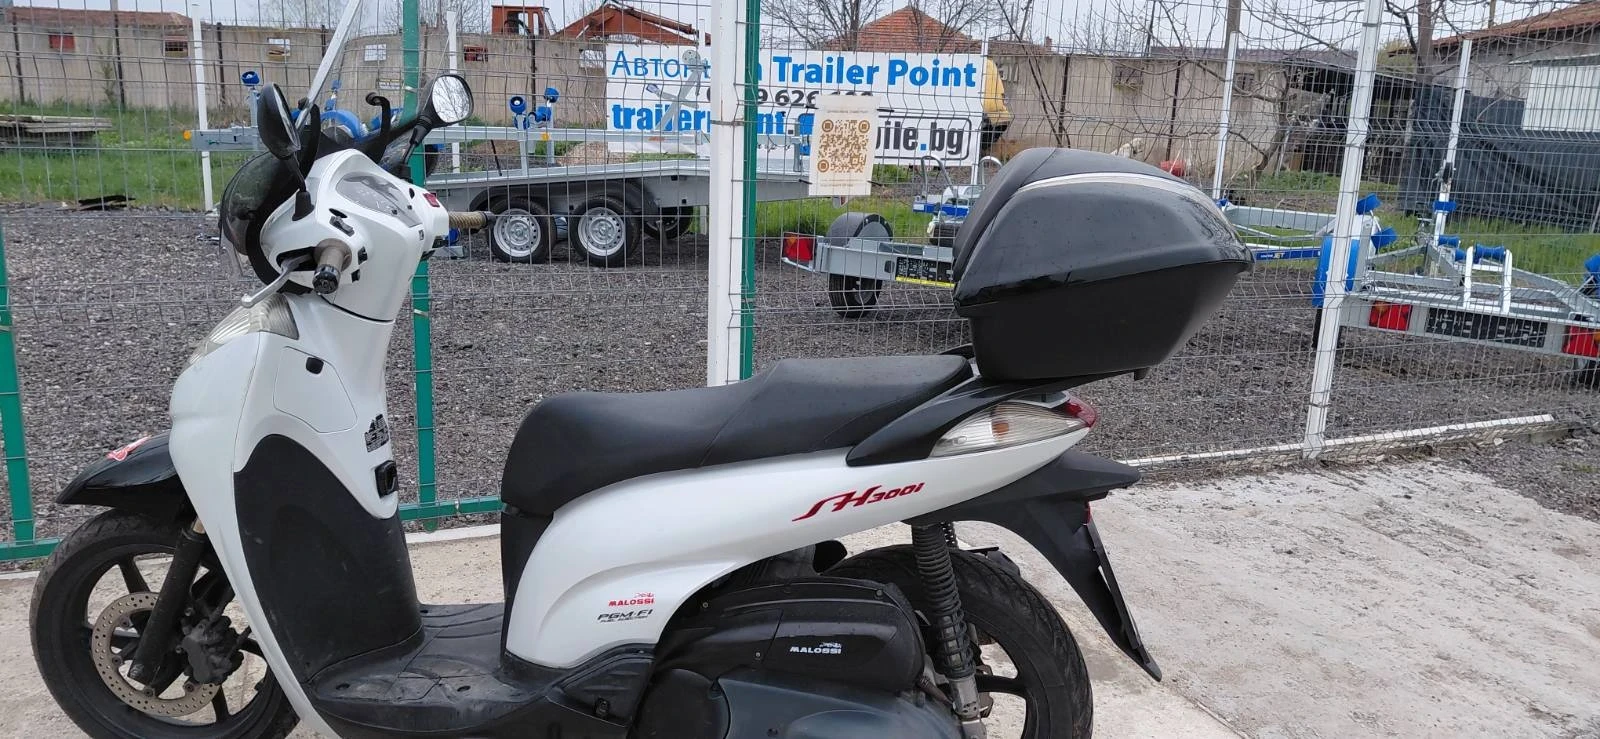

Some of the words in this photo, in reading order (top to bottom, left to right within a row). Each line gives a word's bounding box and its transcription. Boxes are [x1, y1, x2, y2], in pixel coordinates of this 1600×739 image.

[773, 56, 879, 85] Trailer
[888, 58, 976, 87] Point
[609, 598, 654, 607] MALOSSI
[790, 646, 842, 655] MALOSSI
